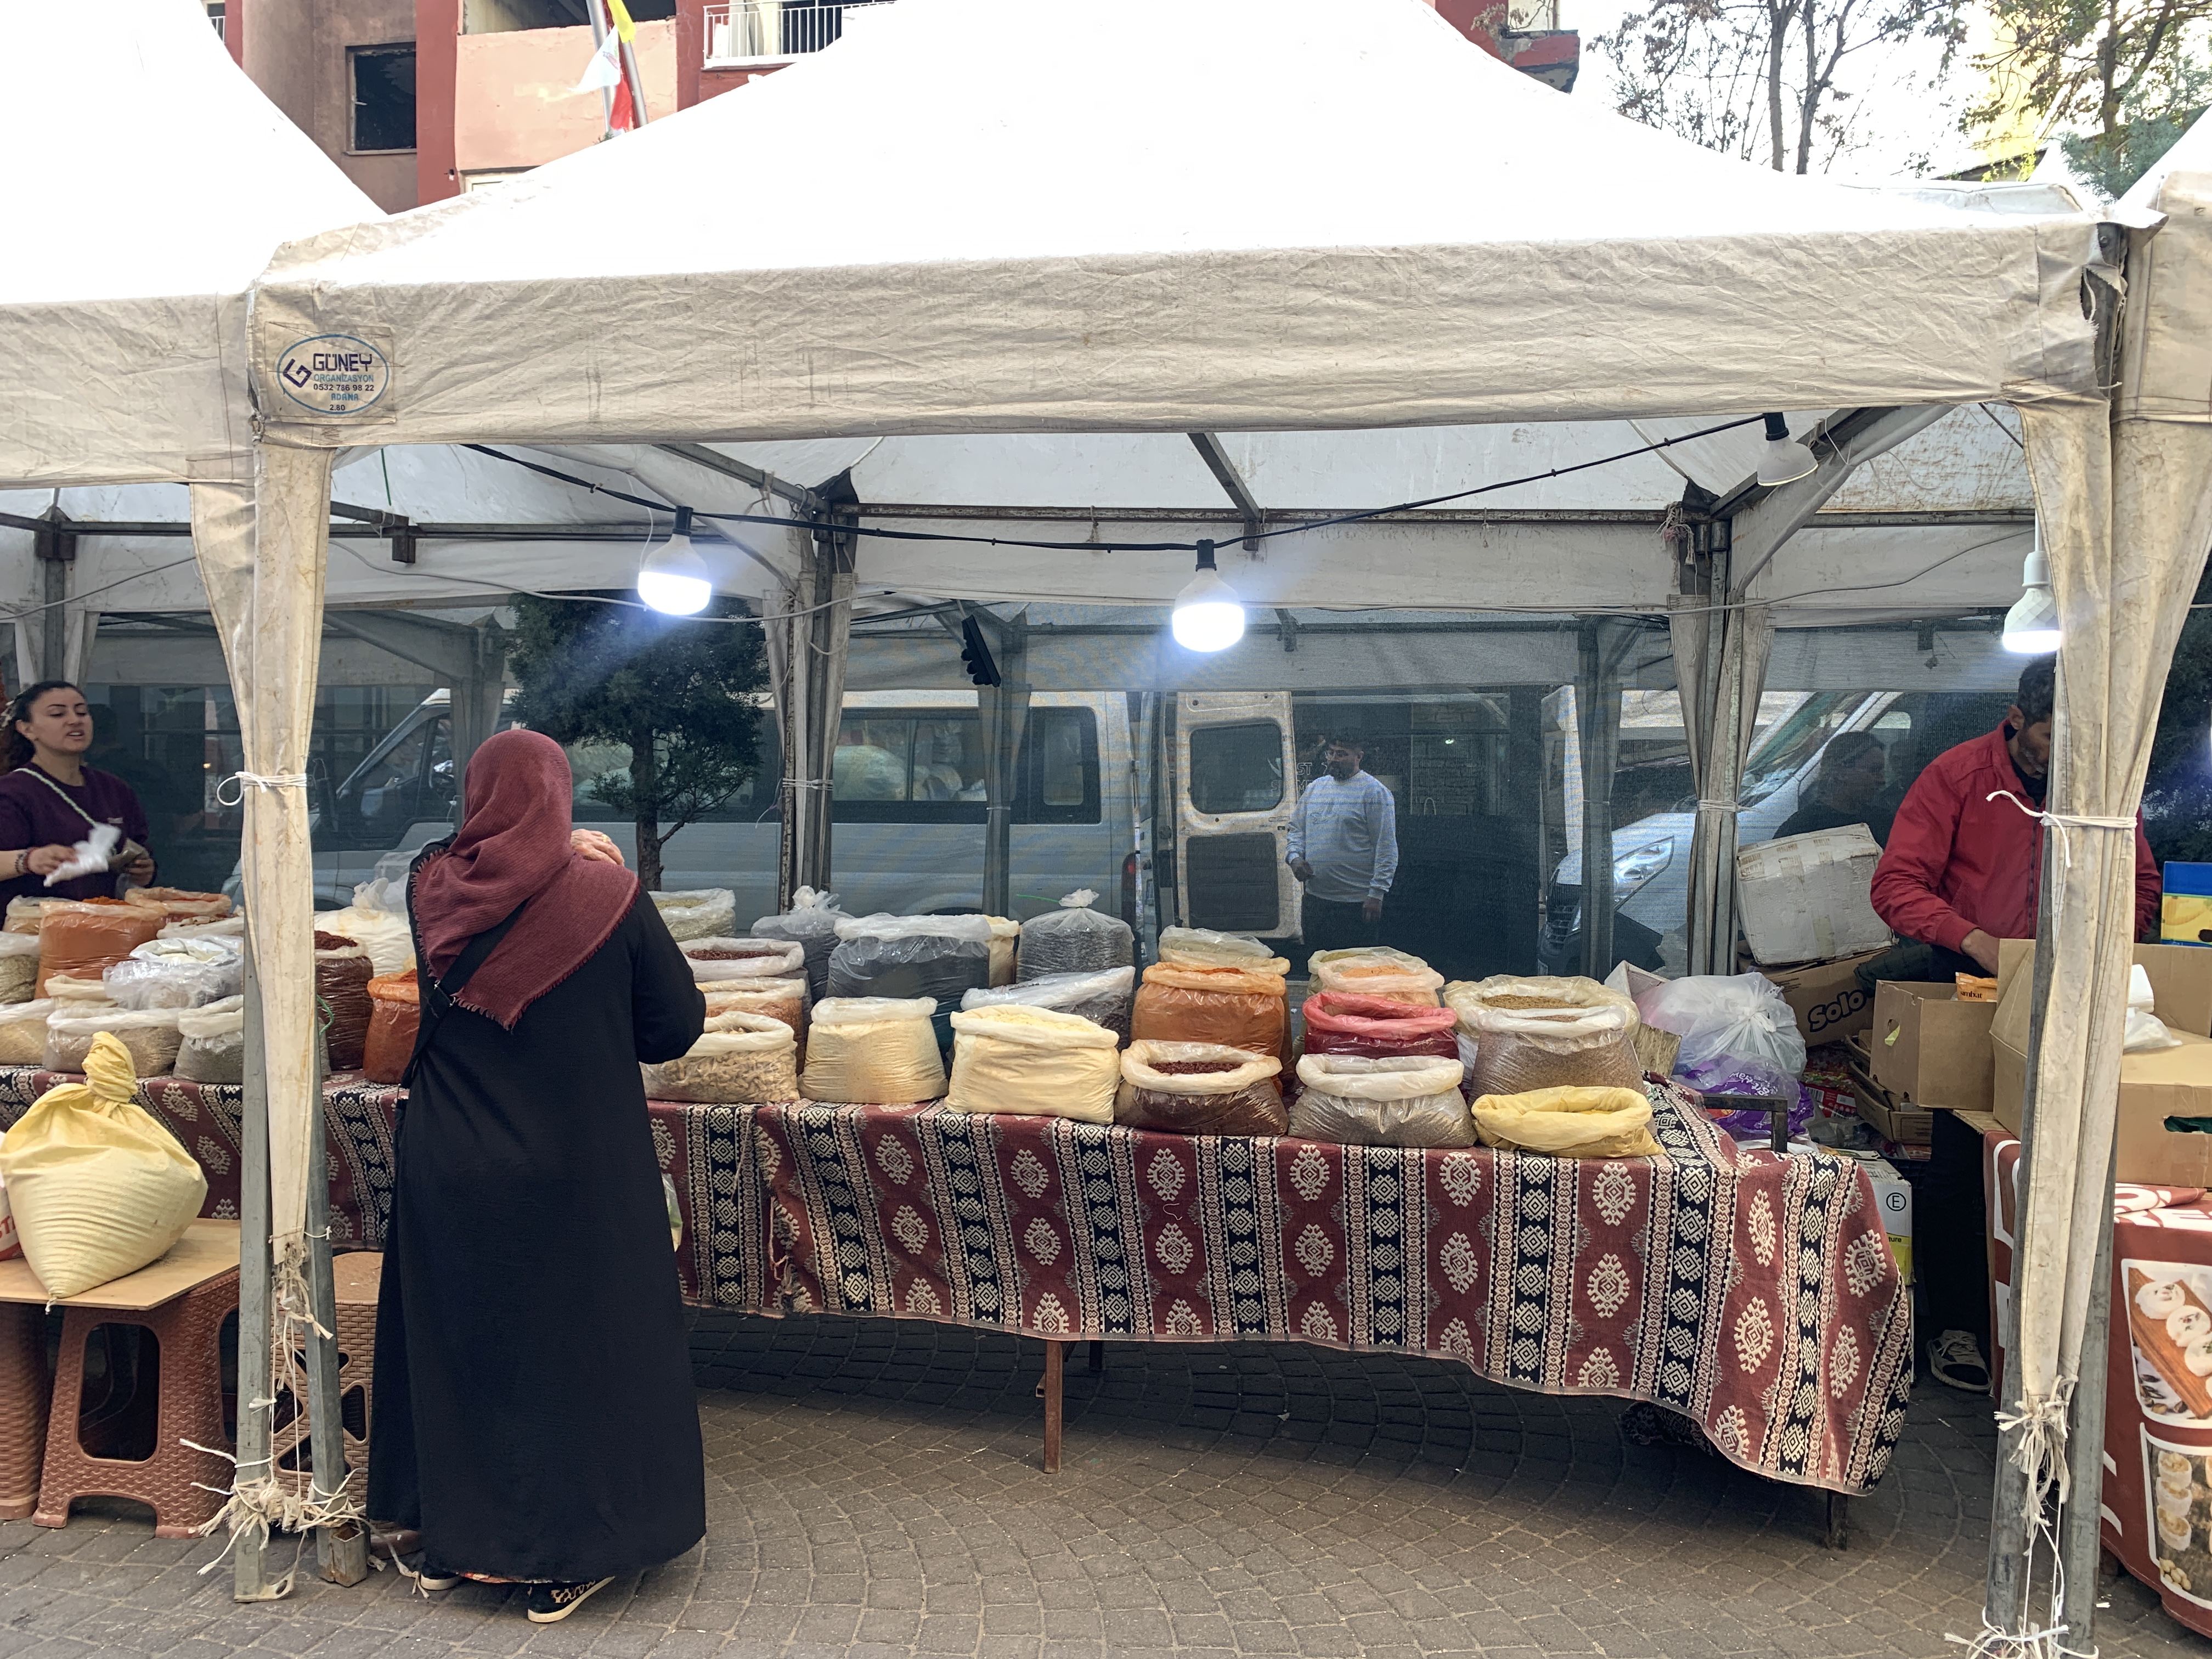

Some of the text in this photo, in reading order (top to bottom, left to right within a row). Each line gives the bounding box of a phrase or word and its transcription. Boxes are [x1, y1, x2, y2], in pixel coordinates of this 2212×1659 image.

[313, 353, 373, 372] GÜNEY
[331, 393, 359, 401] ADANA
[1807, 989, 1867, 1032] Solo
